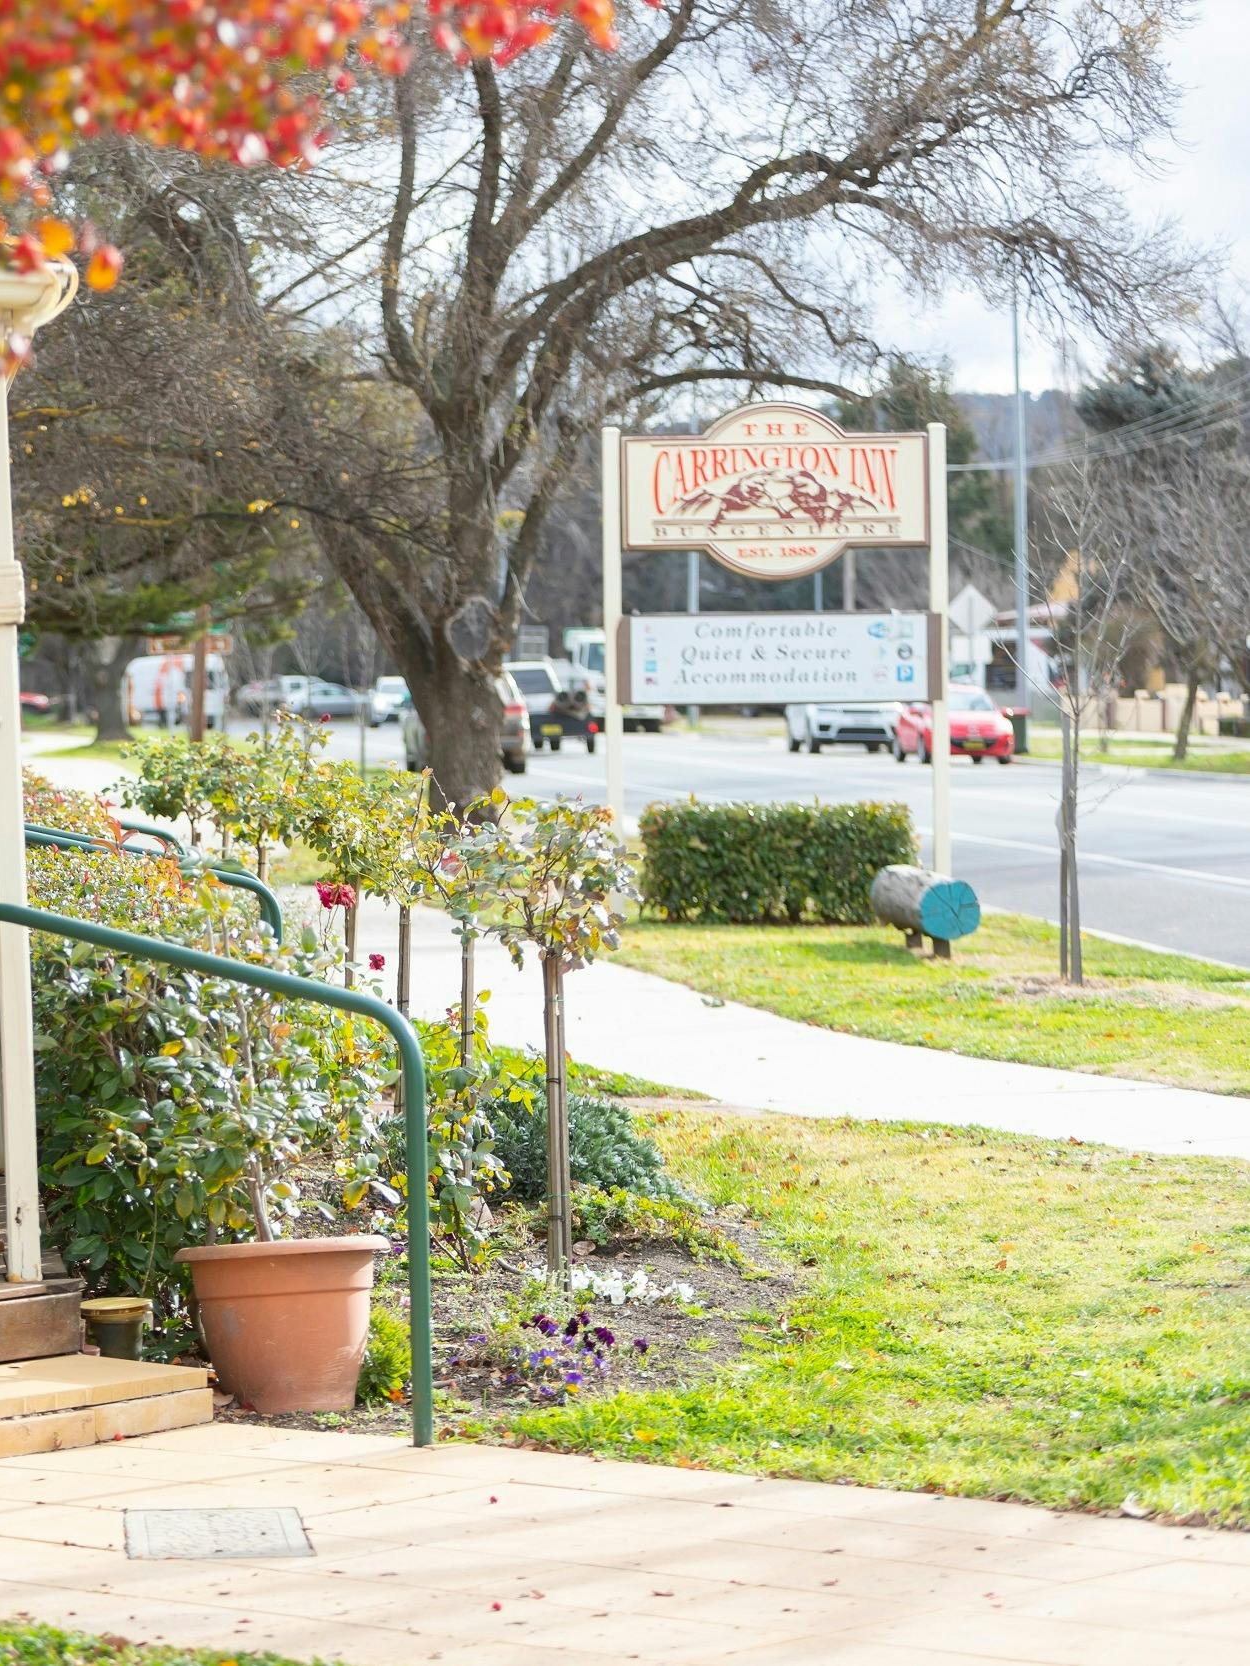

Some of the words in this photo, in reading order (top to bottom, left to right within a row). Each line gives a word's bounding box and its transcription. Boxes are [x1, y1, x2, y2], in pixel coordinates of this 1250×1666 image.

[743, 423, 810, 436] THE
[653, 445, 841, 516] CARRINGTON
[850, 448, 898, 511] INN
[654, 523, 900, 537] BUNGENDORE
[737, 546, 774, 559] EST.
[694, 621, 838, 641] Comfortable
[680, 645, 743, 665] Quiet
[750, 645, 767, 661] &
[774, 644, 852, 661] Secure
[674, 667, 859, 686] Accommodation
